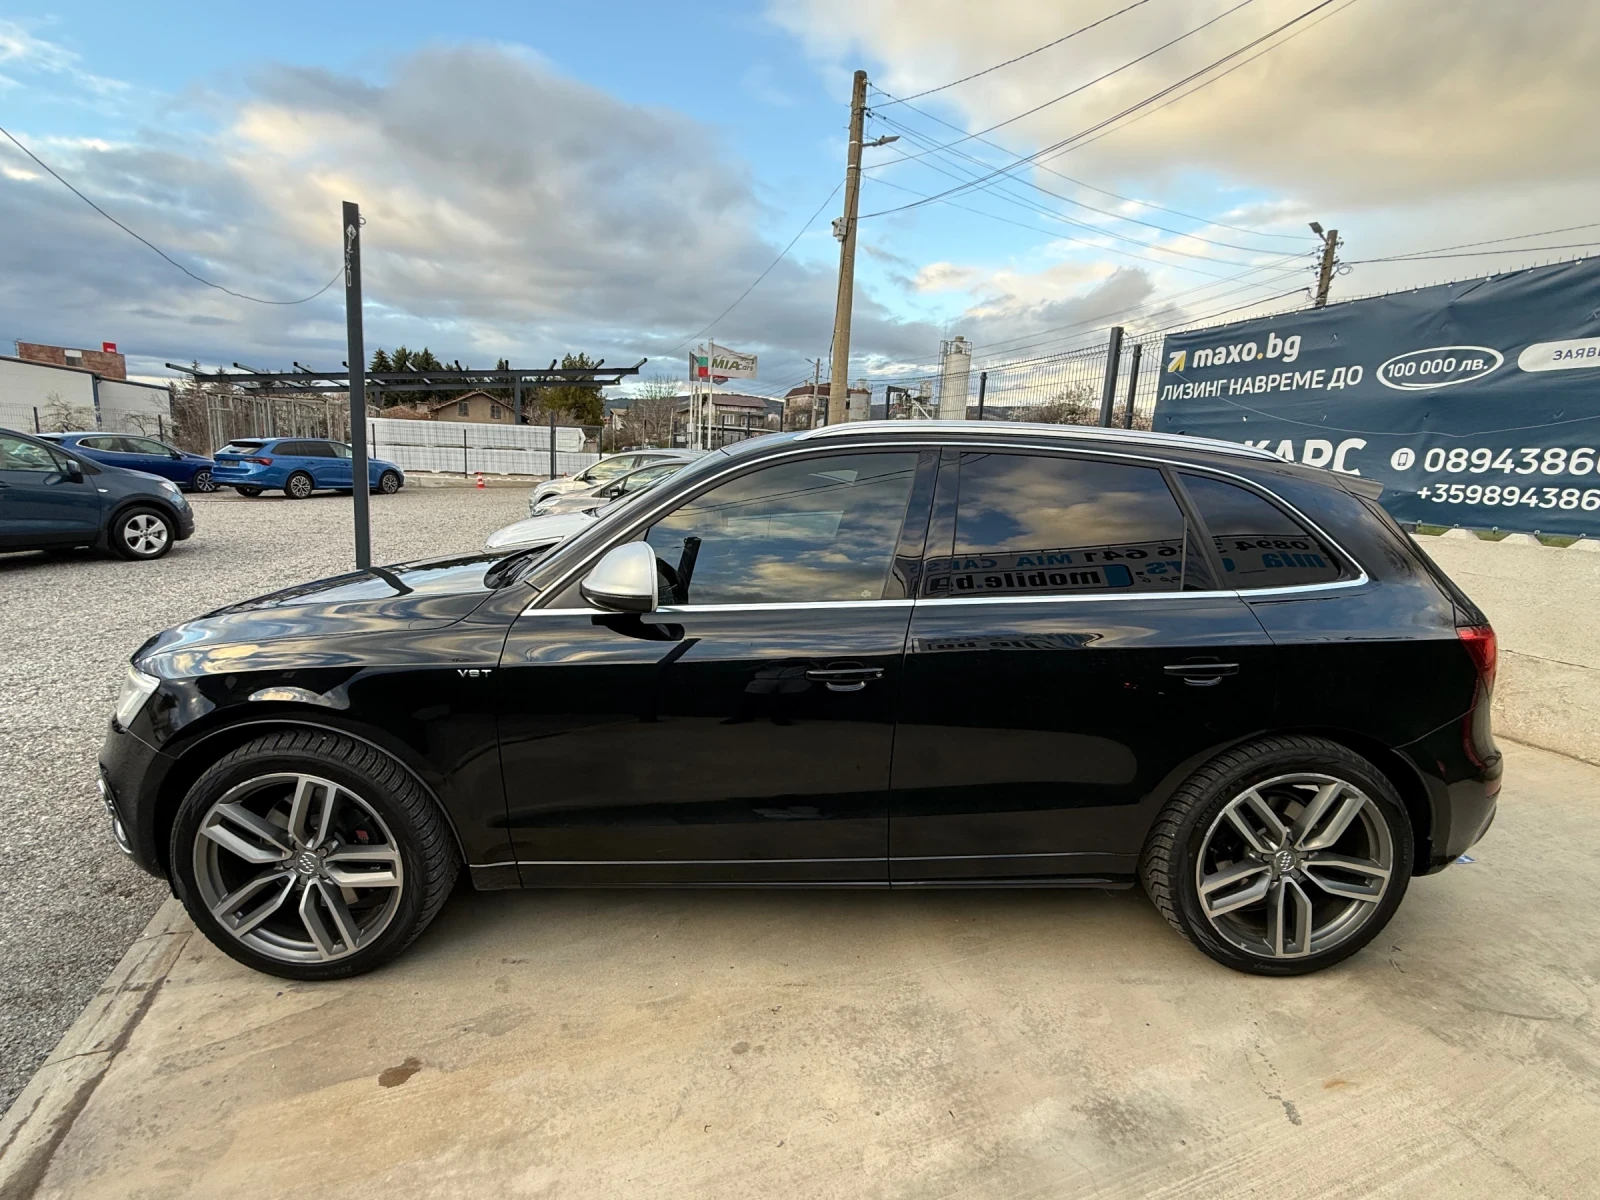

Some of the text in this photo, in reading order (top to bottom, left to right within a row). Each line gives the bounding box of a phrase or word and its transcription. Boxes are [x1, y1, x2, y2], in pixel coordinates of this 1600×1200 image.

[711, 358, 740, 371] MIA
[1192, 332, 1302, 368] maxo.bg
[1387, 357, 1489, 378] 100 000 лв.
[1160, 365, 1364, 401] ЛИЗИНГ НАВРЕМЕ ДО
[1424, 447, 1600, 476] 0894386
